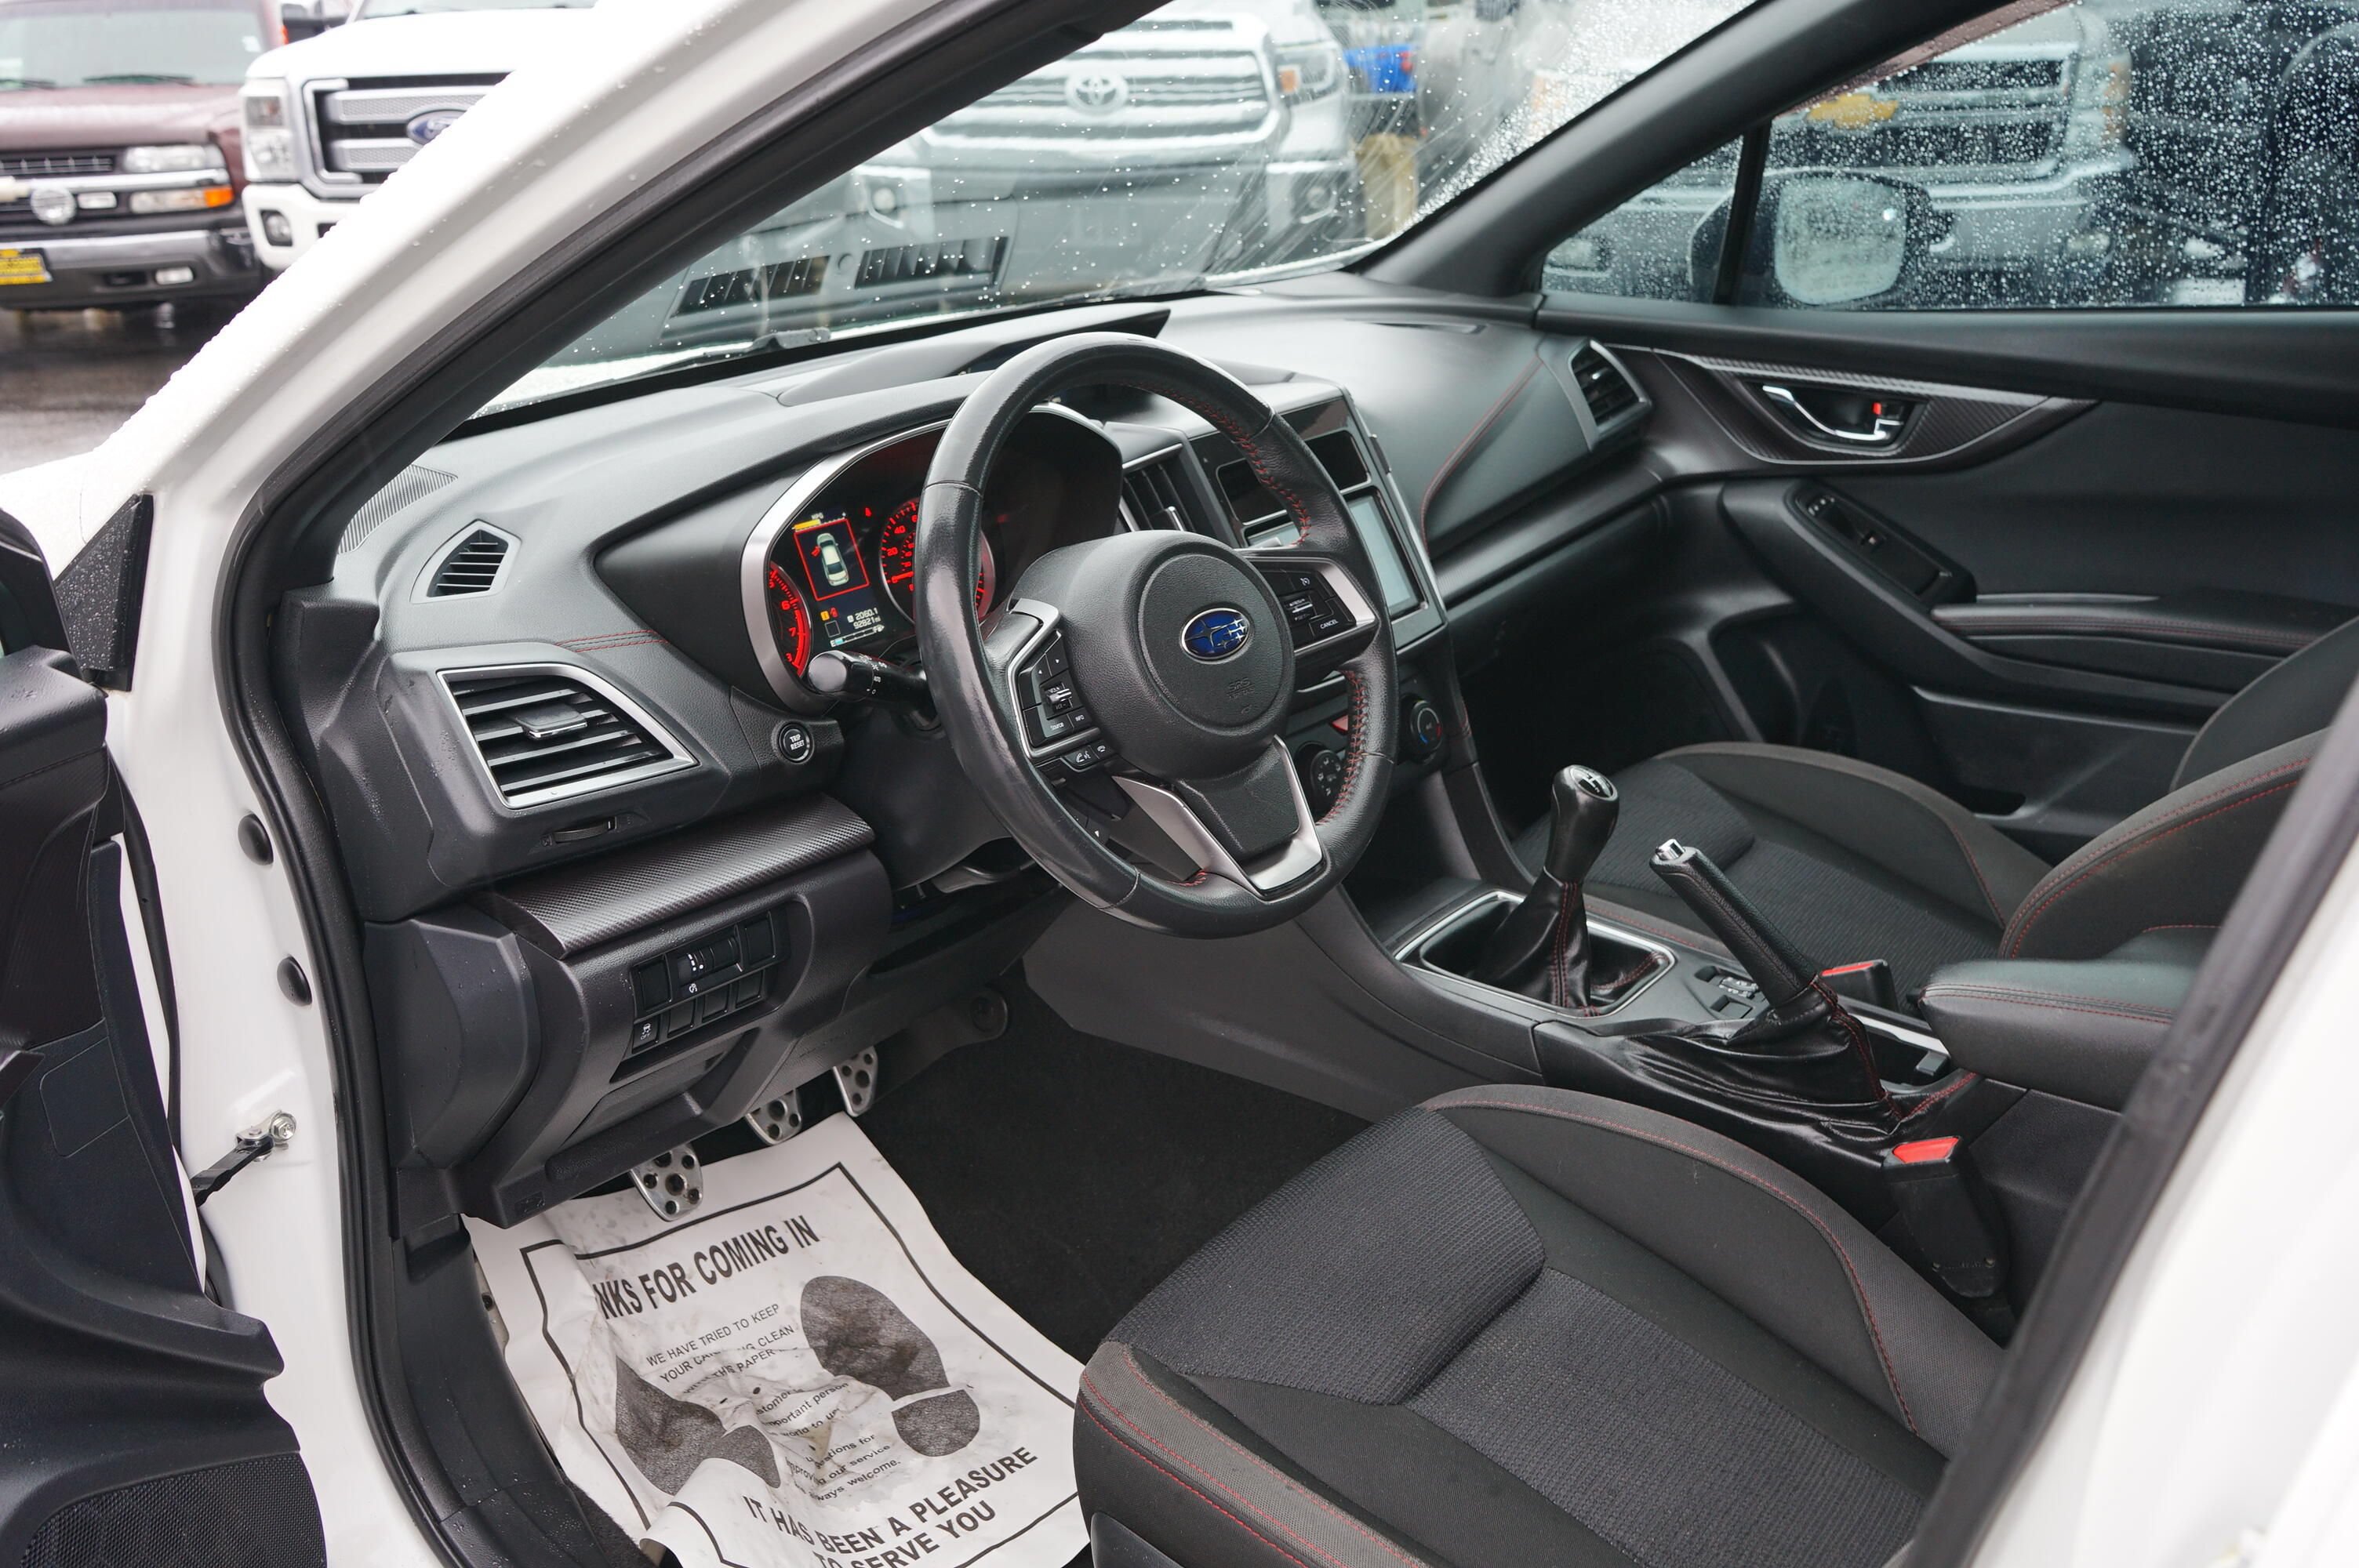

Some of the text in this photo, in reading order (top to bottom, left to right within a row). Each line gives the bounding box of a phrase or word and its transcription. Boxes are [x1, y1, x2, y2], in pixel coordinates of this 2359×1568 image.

[886, 546, 898, 556] 20
[781, 600, 791, 611] 6
[789, 627, 797, 637] 7
[1320, 619, 1339, 629] CANCEL
[790, 734, 801, 743] TRIP
[791, 739, 805, 750] RESET
[592, 1215, 820, 1319] NKS FOR COMING IN
[646, 1352, 667, 1367] WE
[667, 1340, 699, 1360] HAVE
[698, 1326, 732, 1347] TRIED
[732, 1318, 751, 1331] TO
[751, 1303, 779, 1324] KEEP
[660, 1324, 795, 1384] YOUR CLEAN
[738, 1348, 776, 1373] PAPER
[812, 1382, 849, 1405] person
[811, 1420, 823, 1428] to
[859, 1435, 875, 1447] for
[829, 1465, 847, 1479] our
[851, 1444, 890, 1467] service
[847, 1458, 901, 1486] welcome.
[742, 1446, 1038, 1554] IT HAS BEEN A PLEASURE
[936, 1499, 996, 1539] YOU
